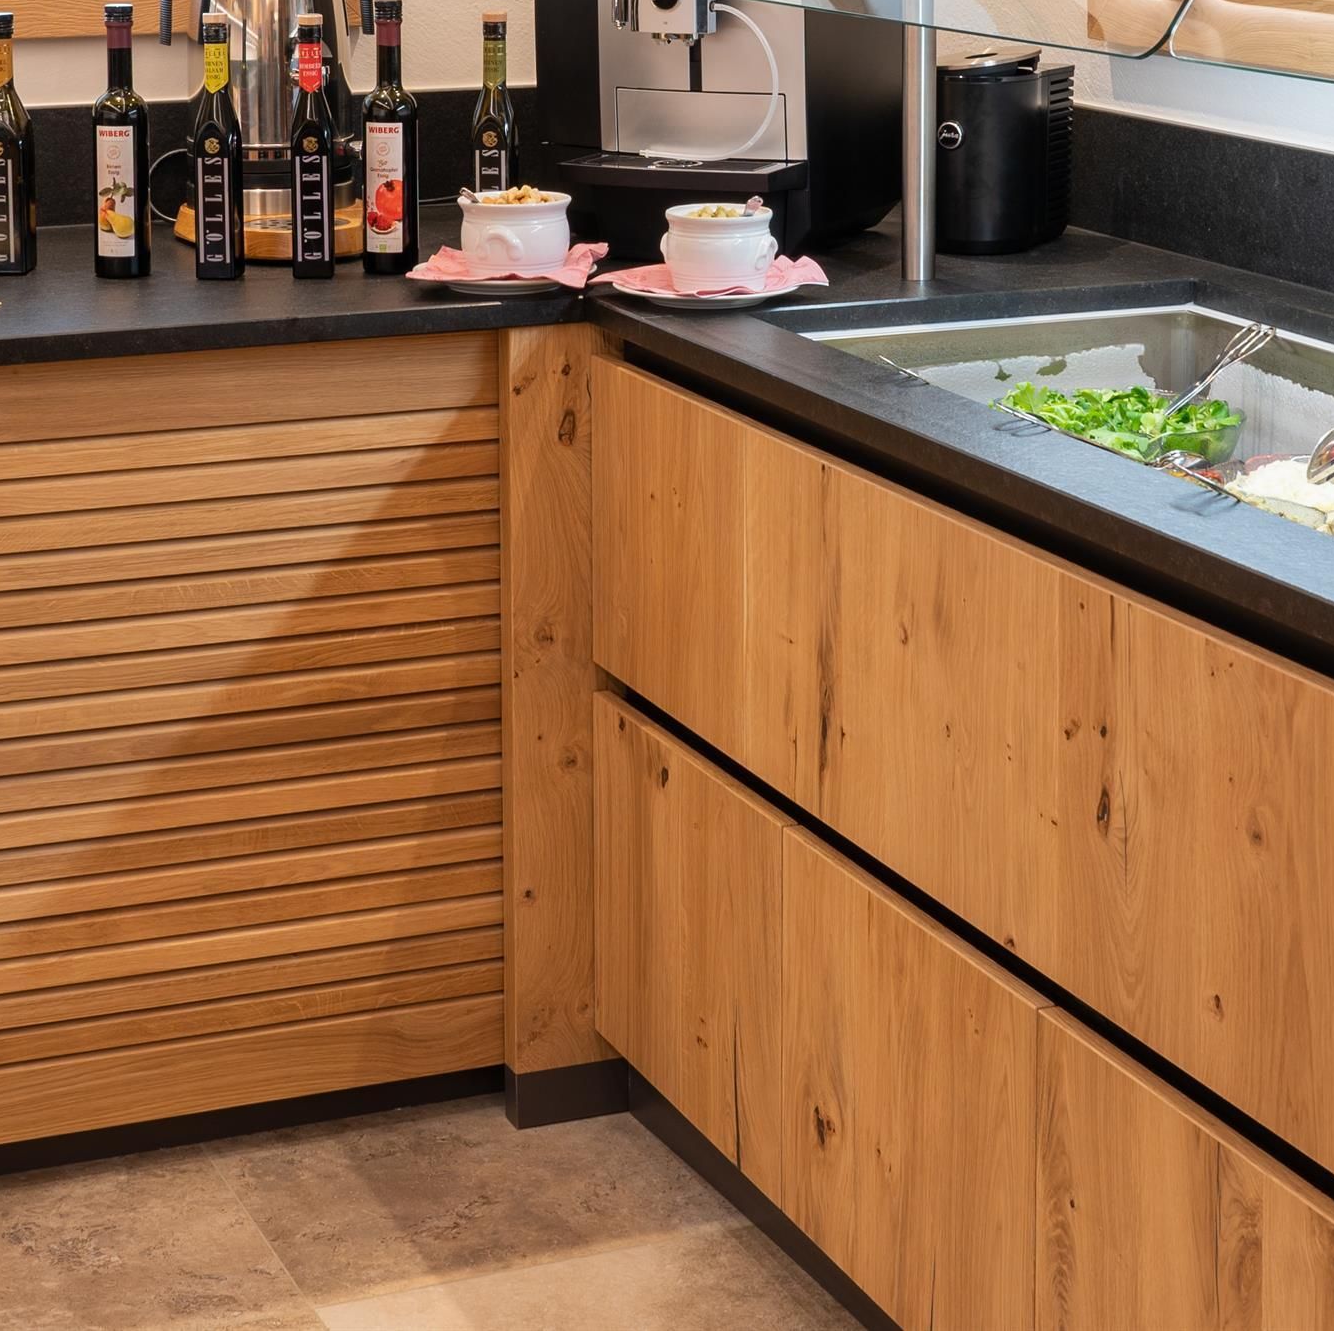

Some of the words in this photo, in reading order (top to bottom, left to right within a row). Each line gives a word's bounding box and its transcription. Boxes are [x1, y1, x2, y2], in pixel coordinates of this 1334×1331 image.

[98, 129, 130, 138] WIBERG
[368, 125, 400, 134] WIBERG
[481, 149, 500, 191] LES
